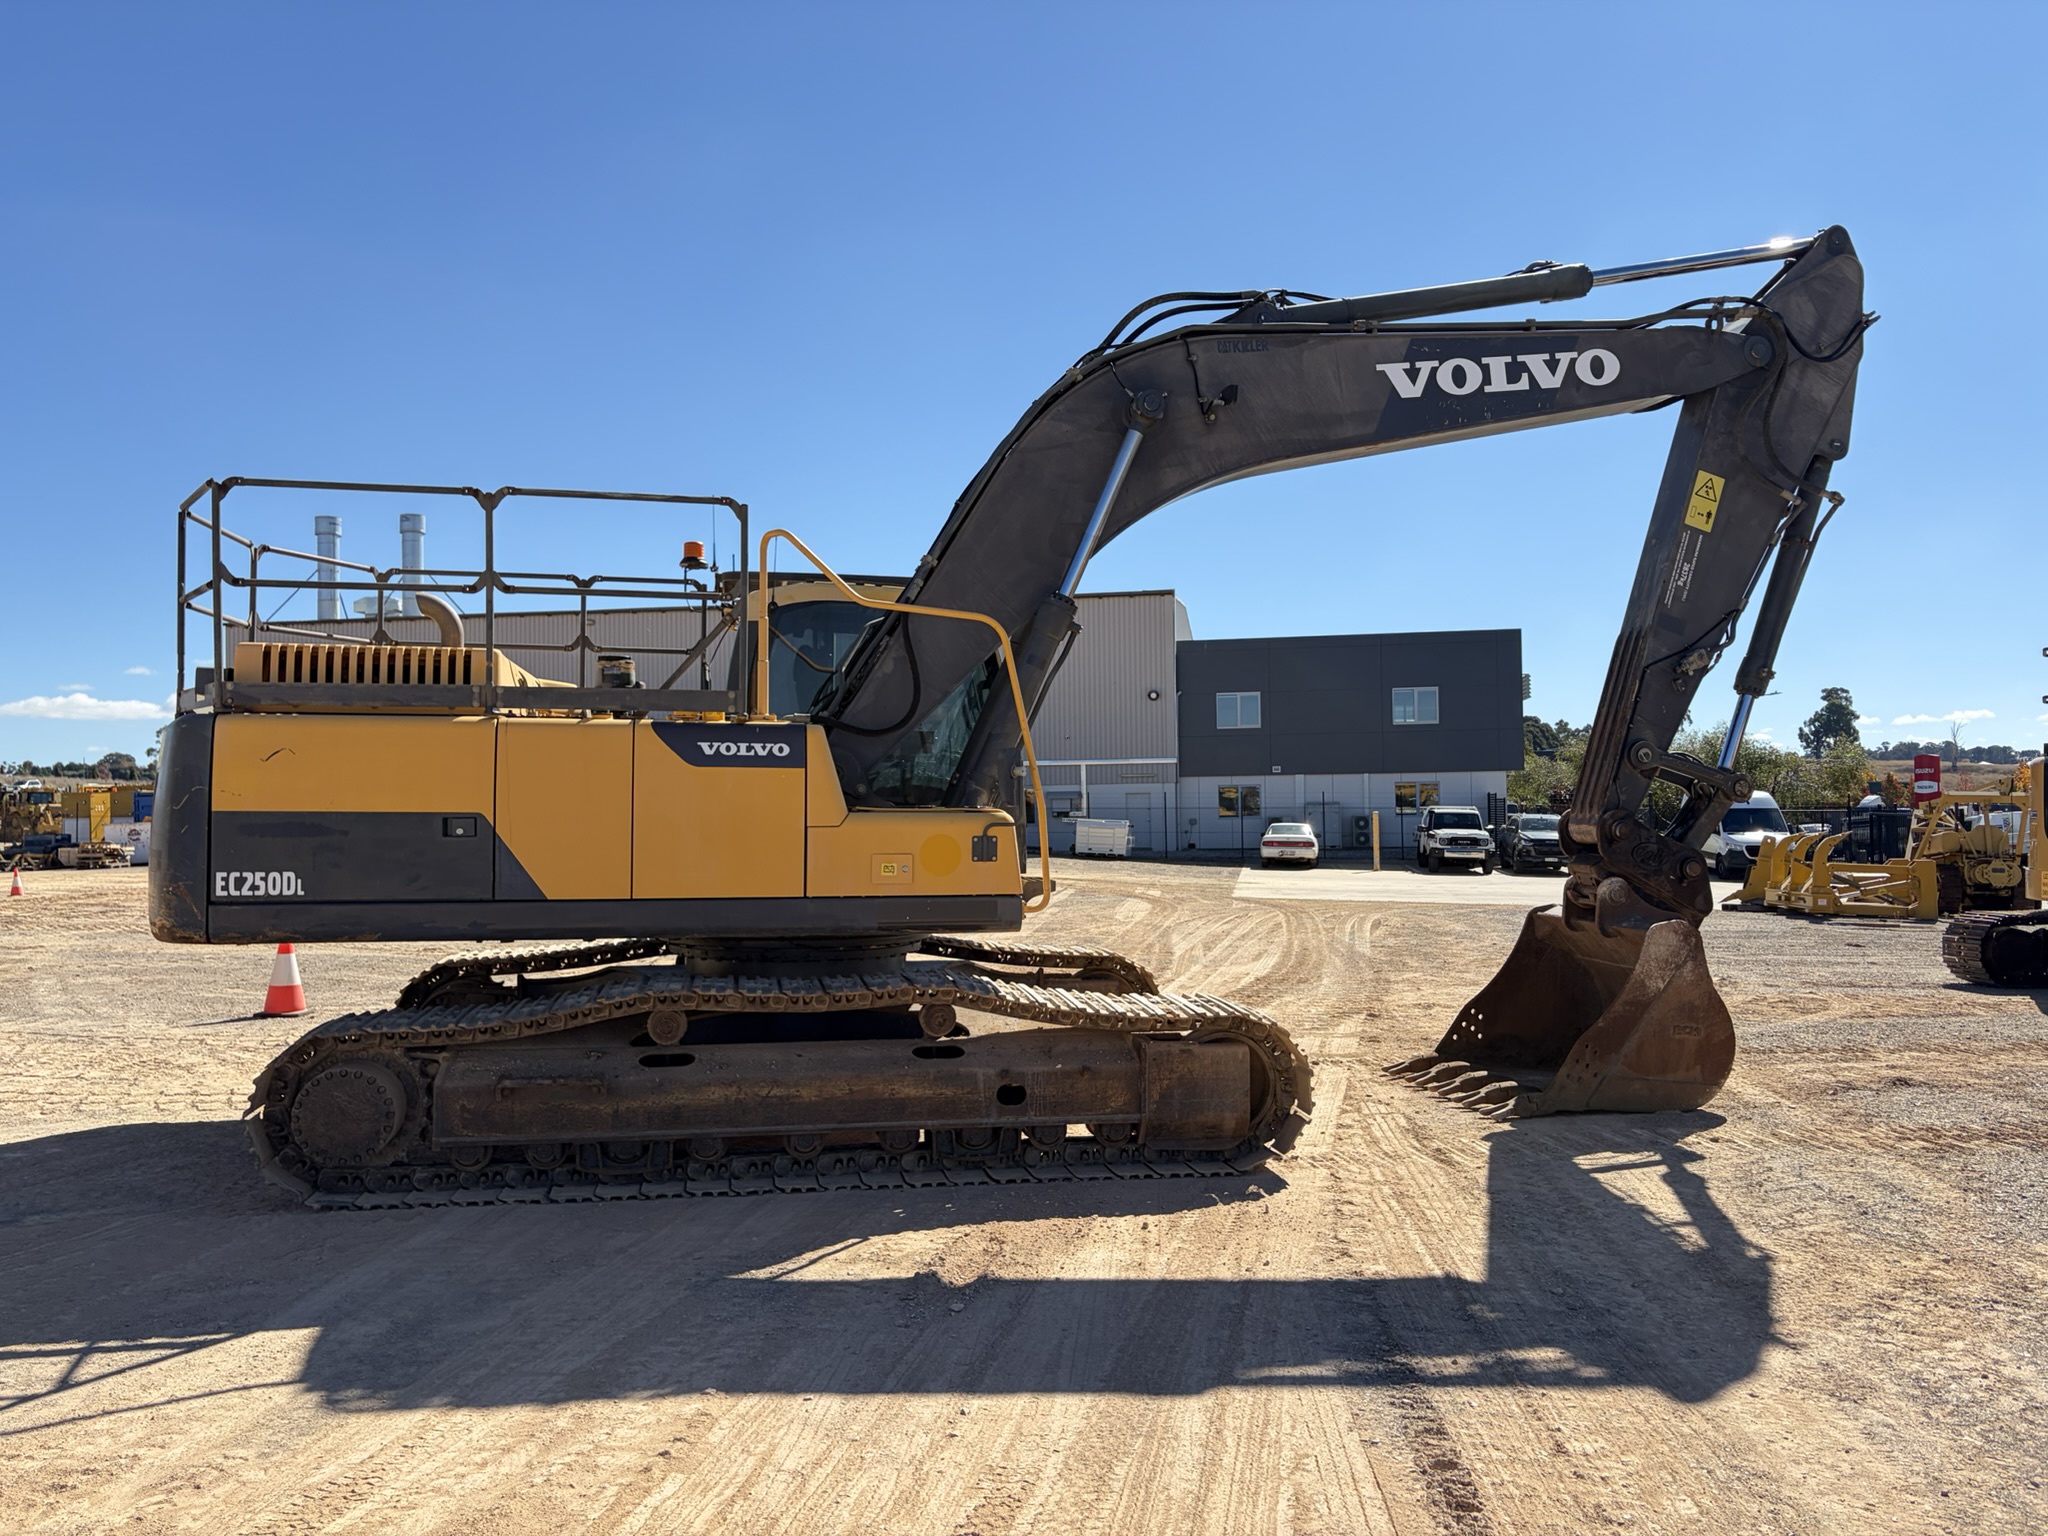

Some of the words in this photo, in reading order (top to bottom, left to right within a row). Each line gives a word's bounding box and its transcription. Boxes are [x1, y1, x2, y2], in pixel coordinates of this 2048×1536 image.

[1376, 348, 1621, 398] VOLVO
[697, 742, 790, 757] VOLVO
[215, 871, 305, 896] EC250DL
